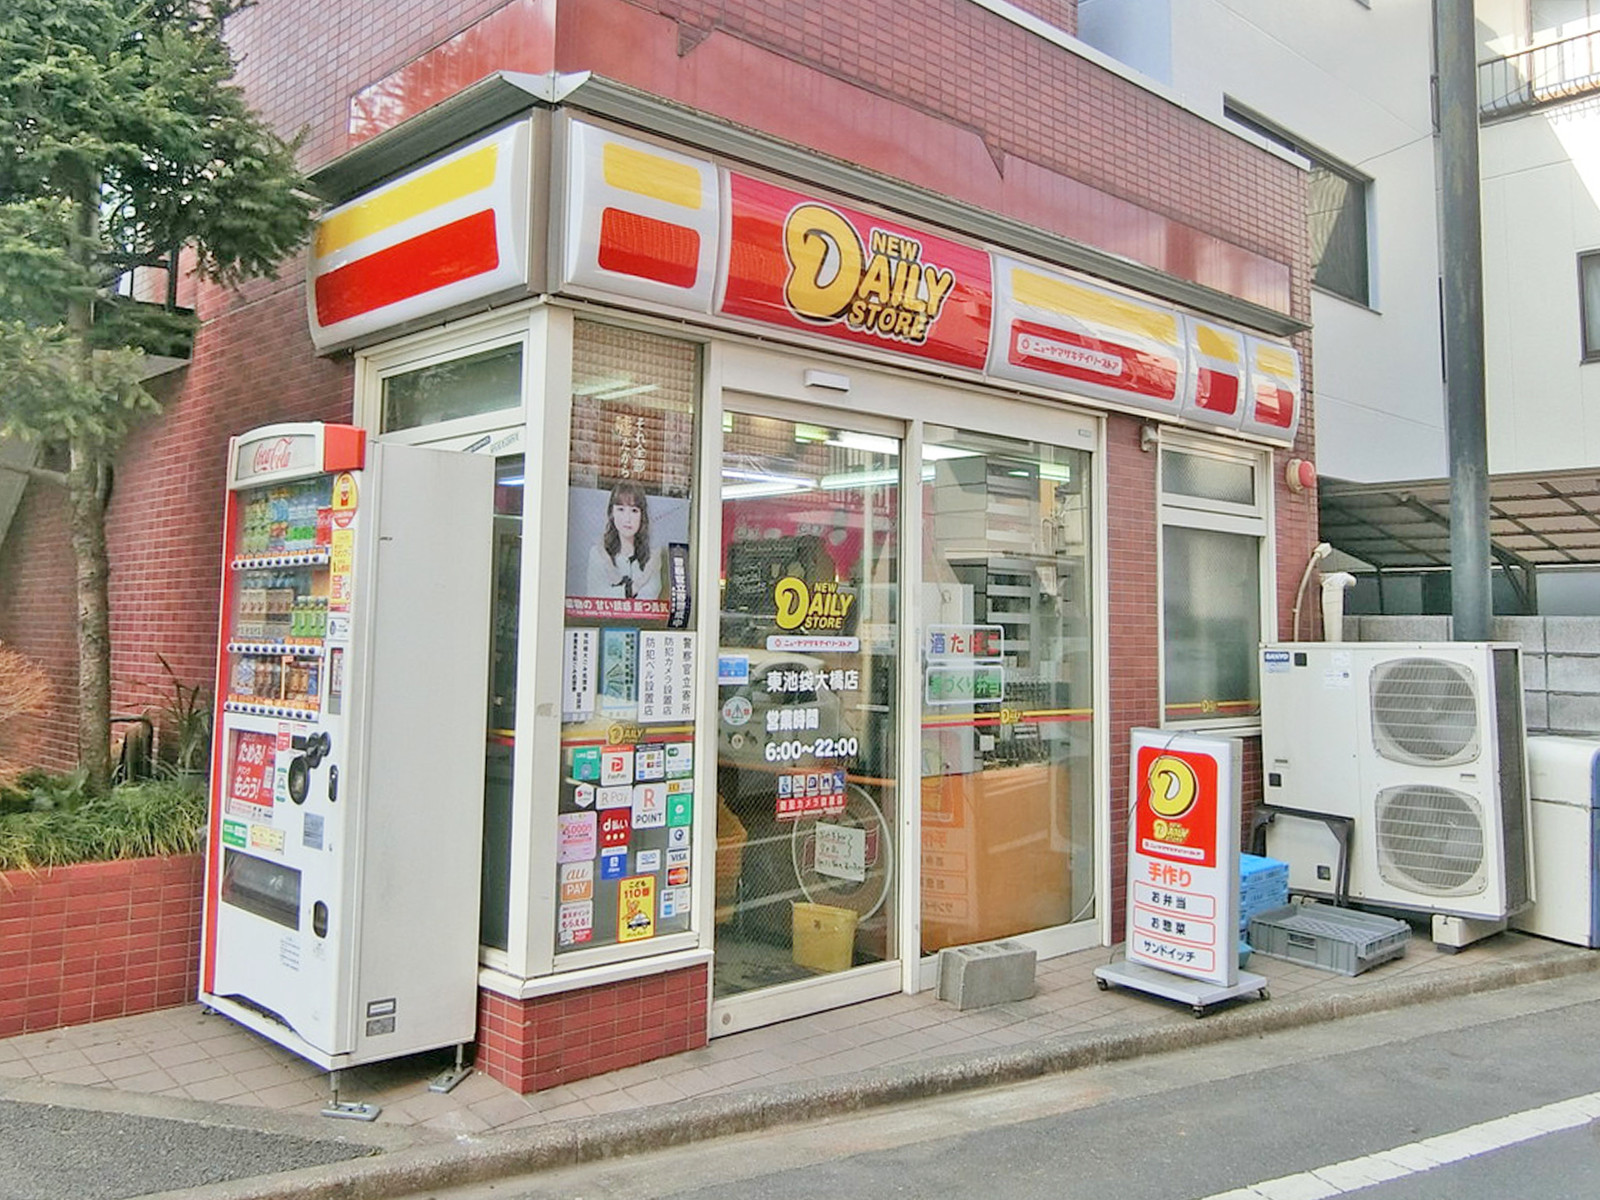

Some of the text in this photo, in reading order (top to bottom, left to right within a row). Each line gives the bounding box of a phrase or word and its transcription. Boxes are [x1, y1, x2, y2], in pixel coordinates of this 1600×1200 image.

[872, 230, 918, 261] NEW
[785, 204, 953, 321] DAILY
[849, 300, 928, 340] STORE
[633, 417, 647, 473] それ全部
[814, 582, 837, 593] NEW
[775, 577, 853, 629] DAILY
[804, 616, 843, 629] STORE
[950, 633, 999, 653] たばこ
[644, 637, 655, 716] 防犯ベル設置店
[663, 637, 674, 715] 防犯カメラ設置店
[767, 670, 859, 692] 東池袋大橋店
[766, 709, 819, 731] 営業時間
[644, 788, 655, 808] R
[636, 812, 662, 823] POINT
[671, 853, 687, 861] VISA
[567, 868, 588, 879] au
[629, 880, 646, 888] こども
[1148, 862, 1191, 887] 手作り
[567, 882, 587, 896] PAY
[1152, 891, 1186, 910] お弁当
[1151, 917, 1186, 936] お惣菜
[1144, 940, 1196, 962] サンドイッチ
